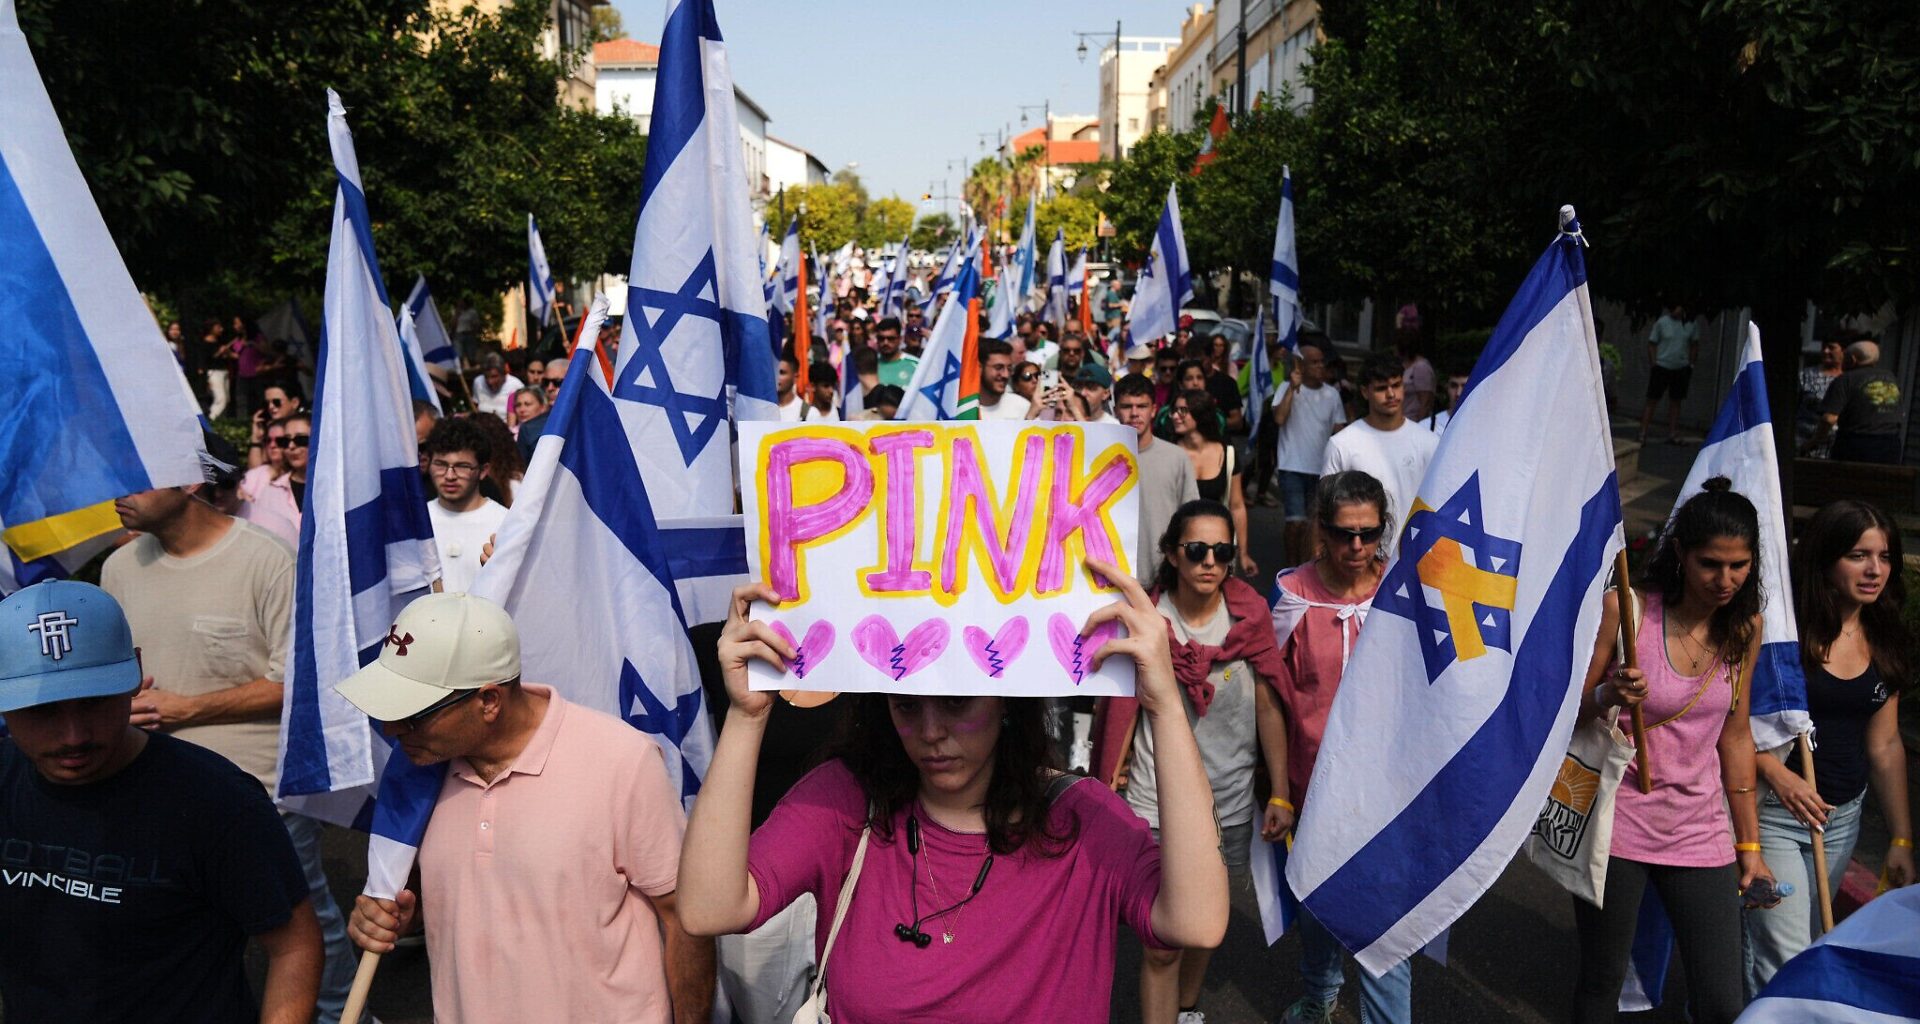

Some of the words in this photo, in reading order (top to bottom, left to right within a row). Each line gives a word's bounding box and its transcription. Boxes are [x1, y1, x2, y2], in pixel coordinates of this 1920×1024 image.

[763, 427, 1135, 604] PINK
[0, 837, 172, 885] OTBALL
[2, 868, 123, 904] VINCIBLE
